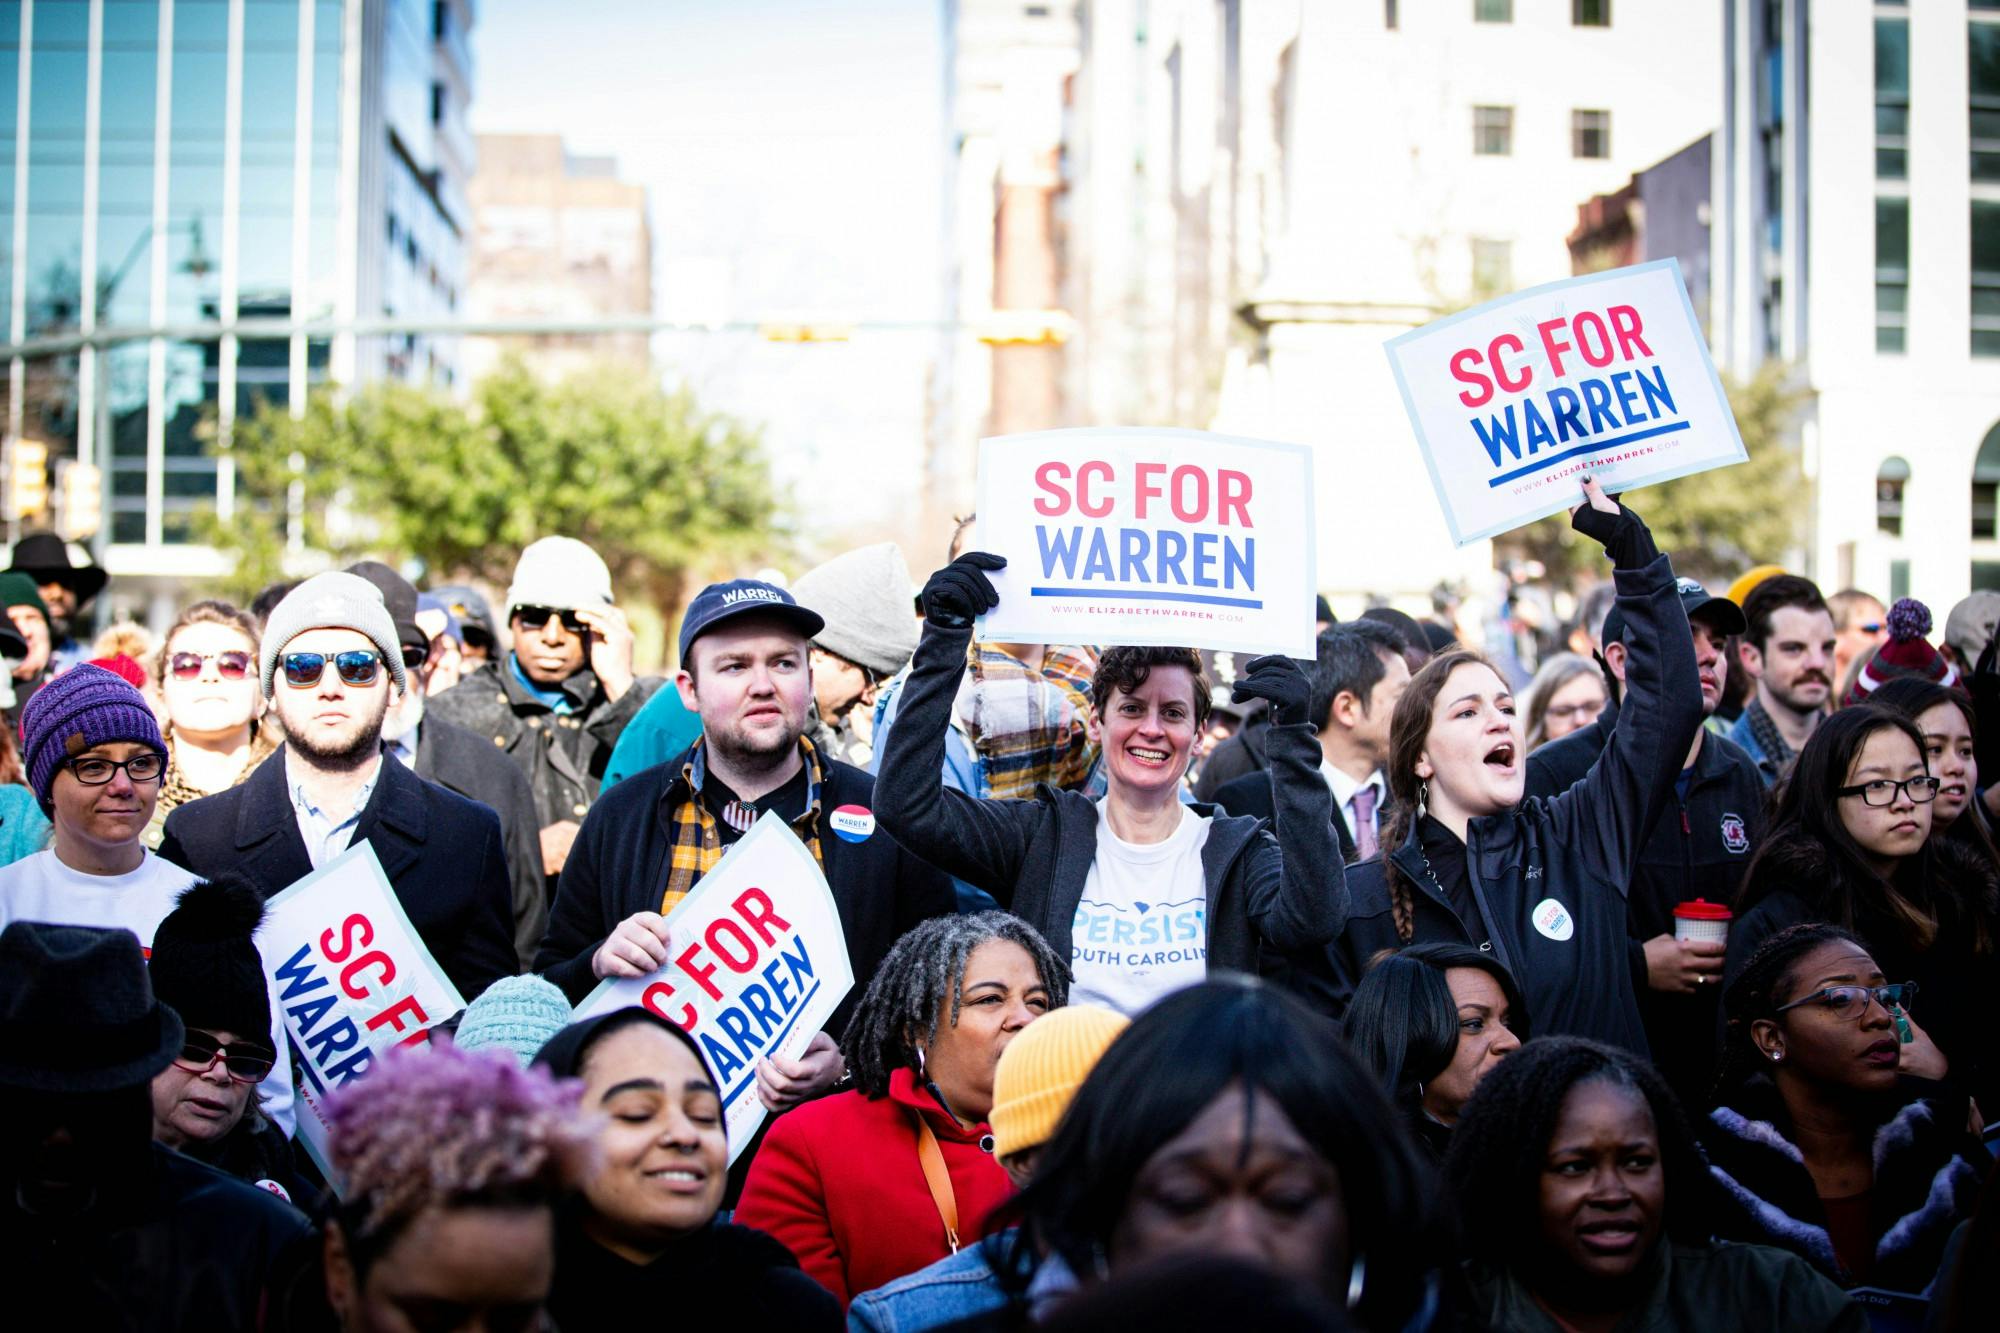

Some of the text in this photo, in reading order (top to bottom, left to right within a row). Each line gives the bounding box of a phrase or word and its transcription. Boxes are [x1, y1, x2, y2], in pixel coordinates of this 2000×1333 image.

[1449, 304, 1654, 408] SC FOR
[1470, 365, 1678, 468] WARREN
[1034, 460, 1254, 528] SC FOR
[721, 588, 784, 604] WARREN
[1035, 525, 1255, 591] WARREN
[838, 817, 868, 828] WARREN
[320, 913, 396, 1000] SC
[675, 887, 792, 1002] FOR
